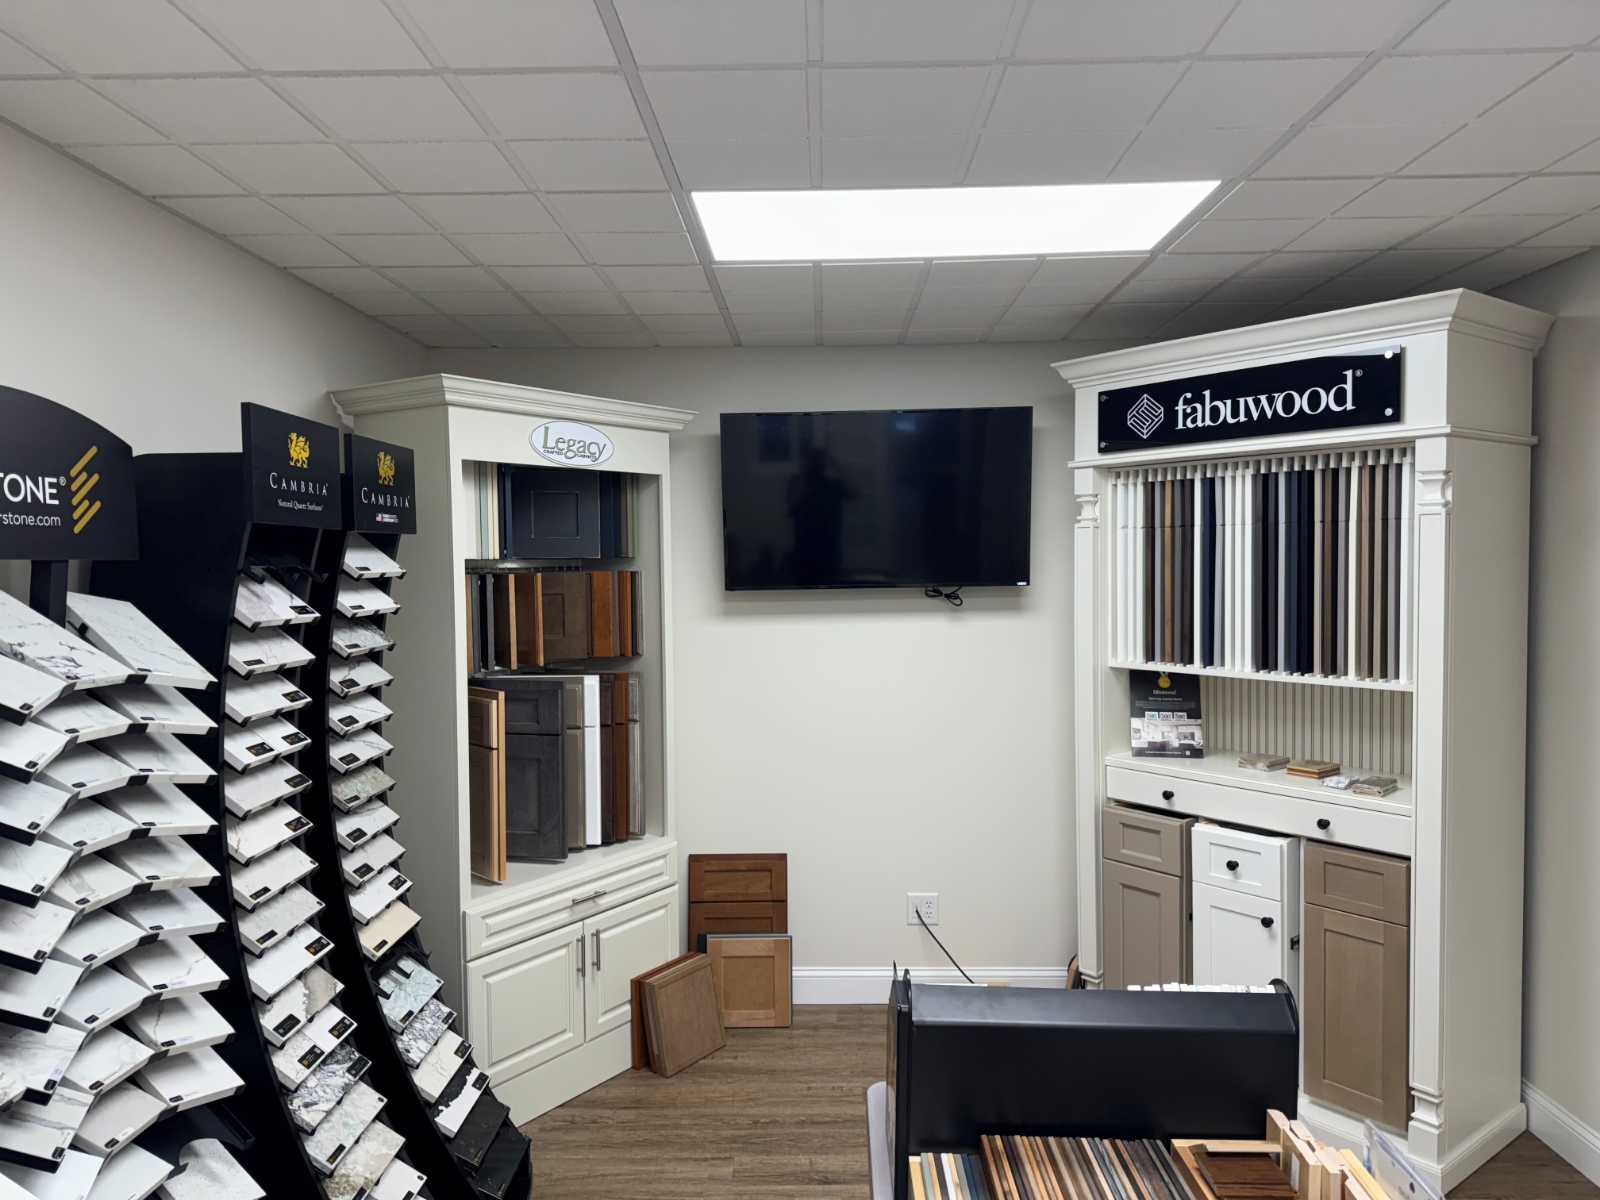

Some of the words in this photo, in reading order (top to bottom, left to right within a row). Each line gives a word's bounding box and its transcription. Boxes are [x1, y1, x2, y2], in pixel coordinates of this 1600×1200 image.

[1175, 369, 1357, 430] fabuwood
[542, 426, 607, 463] Legacy
[0, 472, 60, 505] ONE
[269, 472, 328, 497] CAMBRIA
[361, 487, 410, 509] CAMBRIA
[0, 511, 61, 527] stone.com
